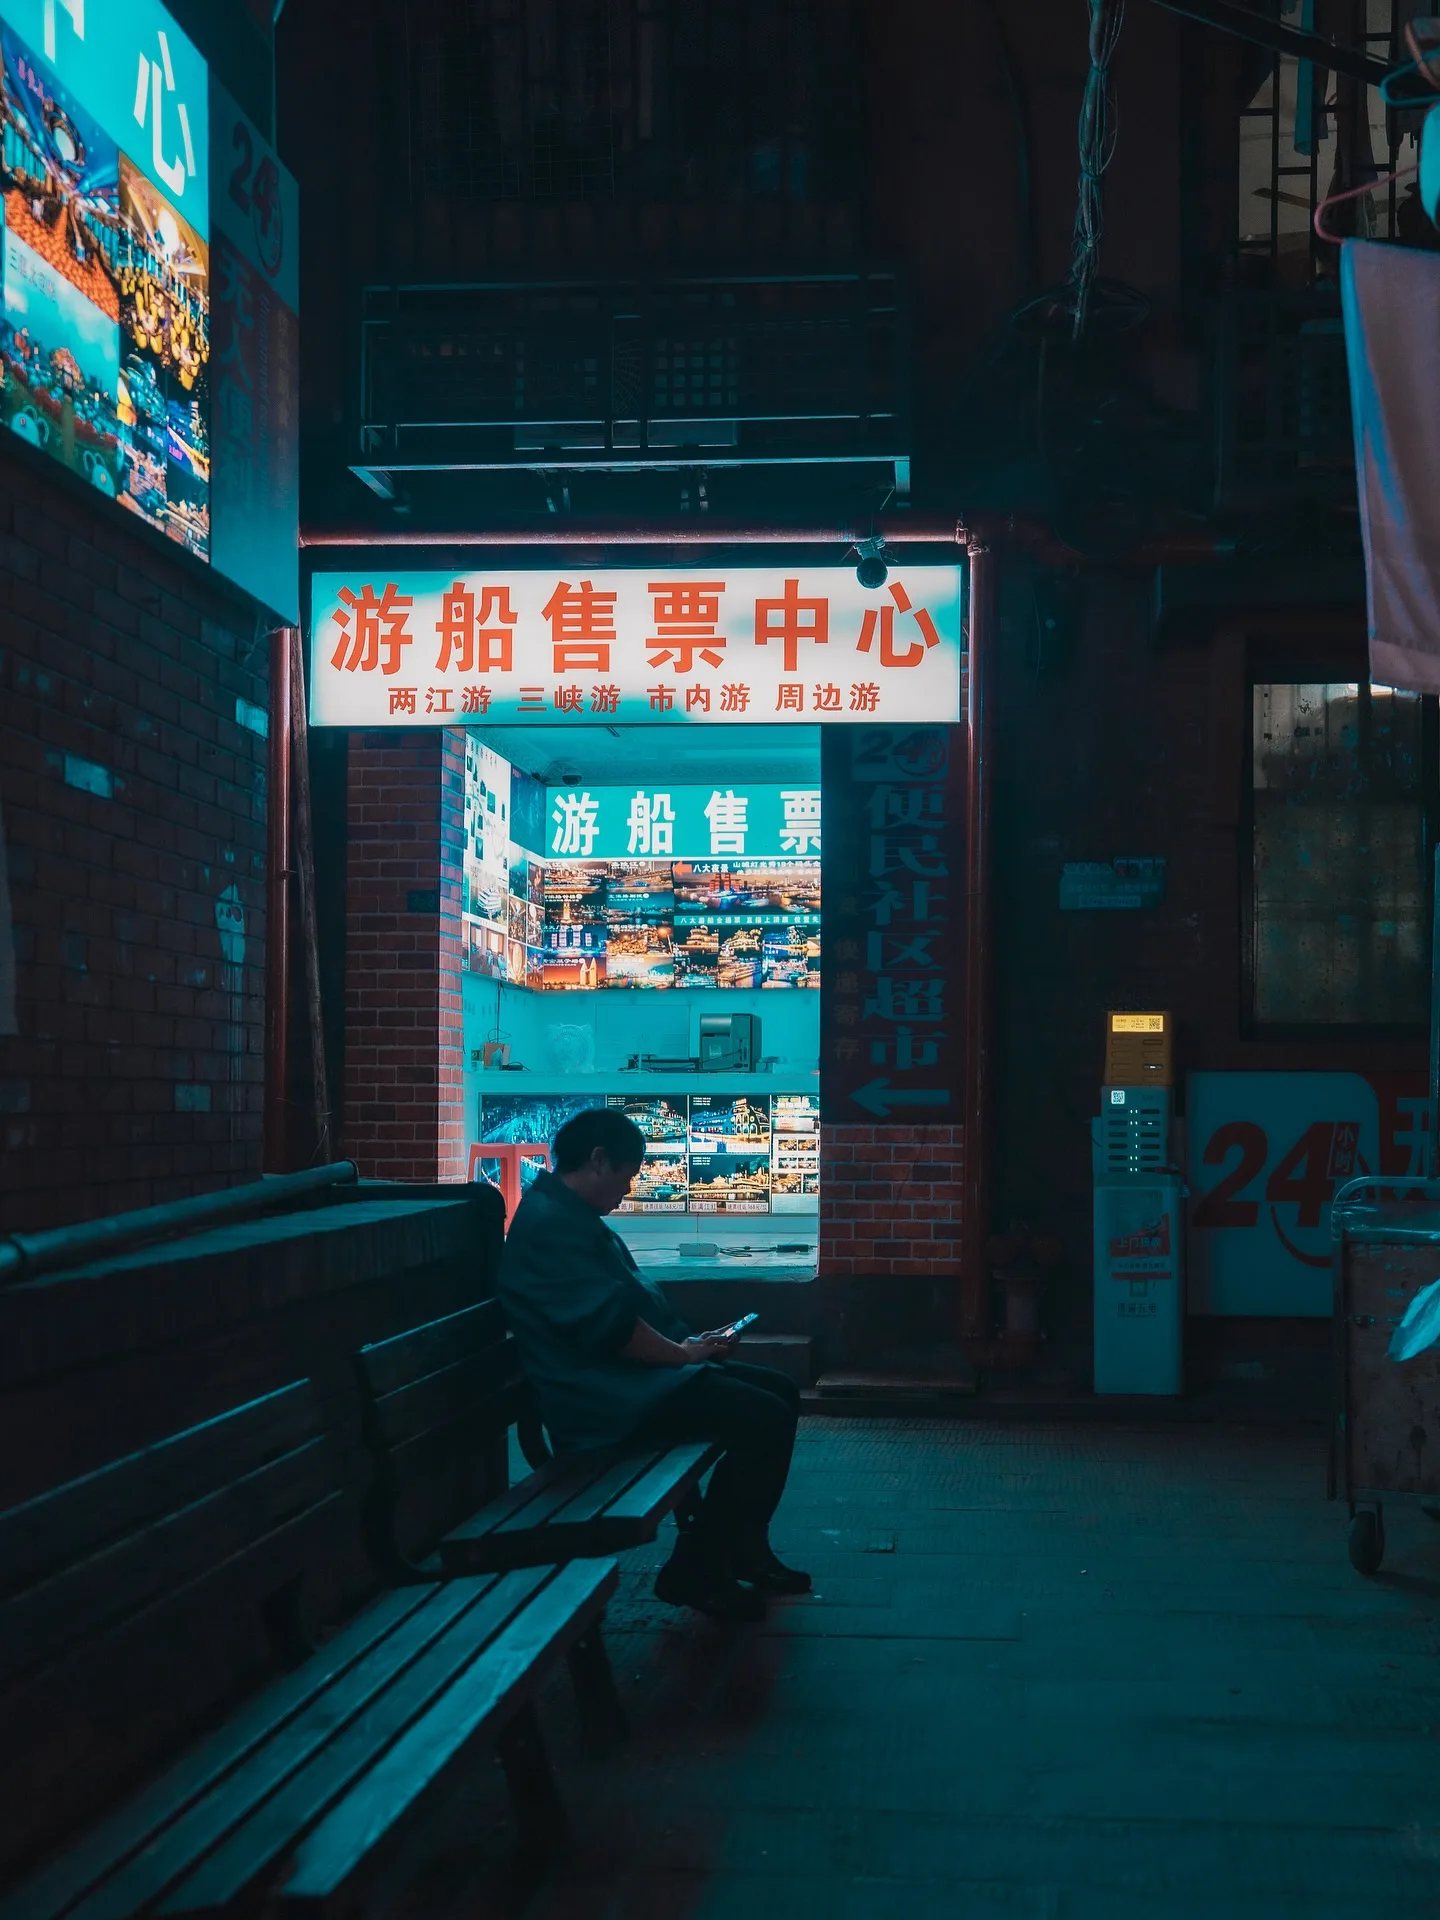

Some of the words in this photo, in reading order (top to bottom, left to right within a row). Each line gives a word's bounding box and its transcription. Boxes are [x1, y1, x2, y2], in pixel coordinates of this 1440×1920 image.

[330, 578, 939, 676] 游船售票中心
[388, 685, 492, 715] 两江游
[518, 683, 621, 714] 三峡游
[647, 684, 751, 714] 市内游
[775, 683, 880, 713] 周边游
[1191, 1119, 1339, 1228] 24
